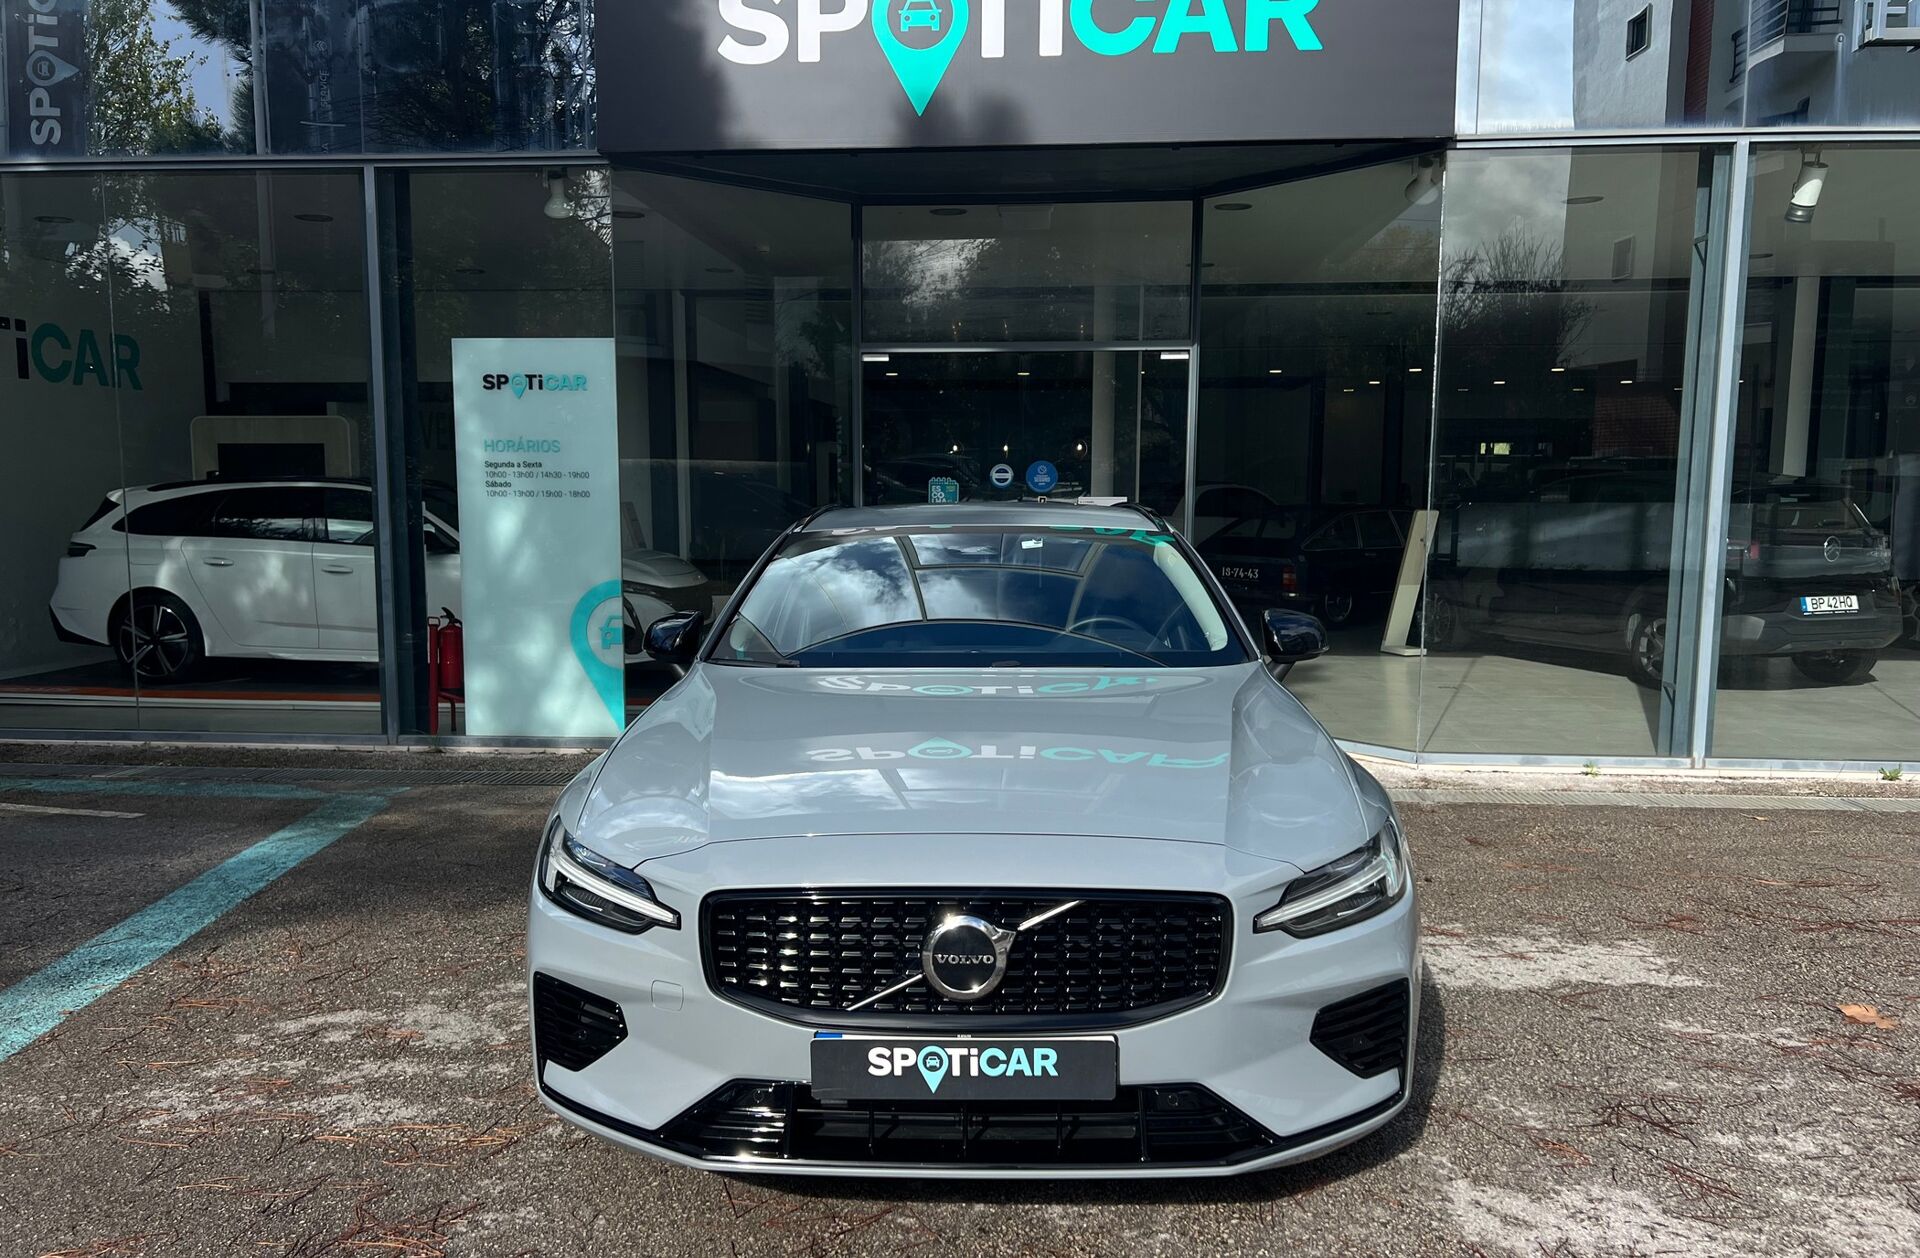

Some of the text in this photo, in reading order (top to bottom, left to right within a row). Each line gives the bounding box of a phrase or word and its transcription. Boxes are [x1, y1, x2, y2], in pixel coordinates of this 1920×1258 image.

[484, 436, 561, 453] HORÁRIOS
[484, 460, 515, 470] Segunda
[522, 460, 543, 469] Sexta
[485, 470, 507, 479] 10h00
[513, 470, 534, 479] 13h00
[541, 471, 562, 479] 14h30
[568, 471, 590, 479] 19h00
[485, 480, 512, 488] Sábado
[486, 489, 508, 498] 10h00
[513, 490, 535, 498] 13h00
[541, 490, 563, 498] 15h00
[934, 954, 995, 965] VOLVO
